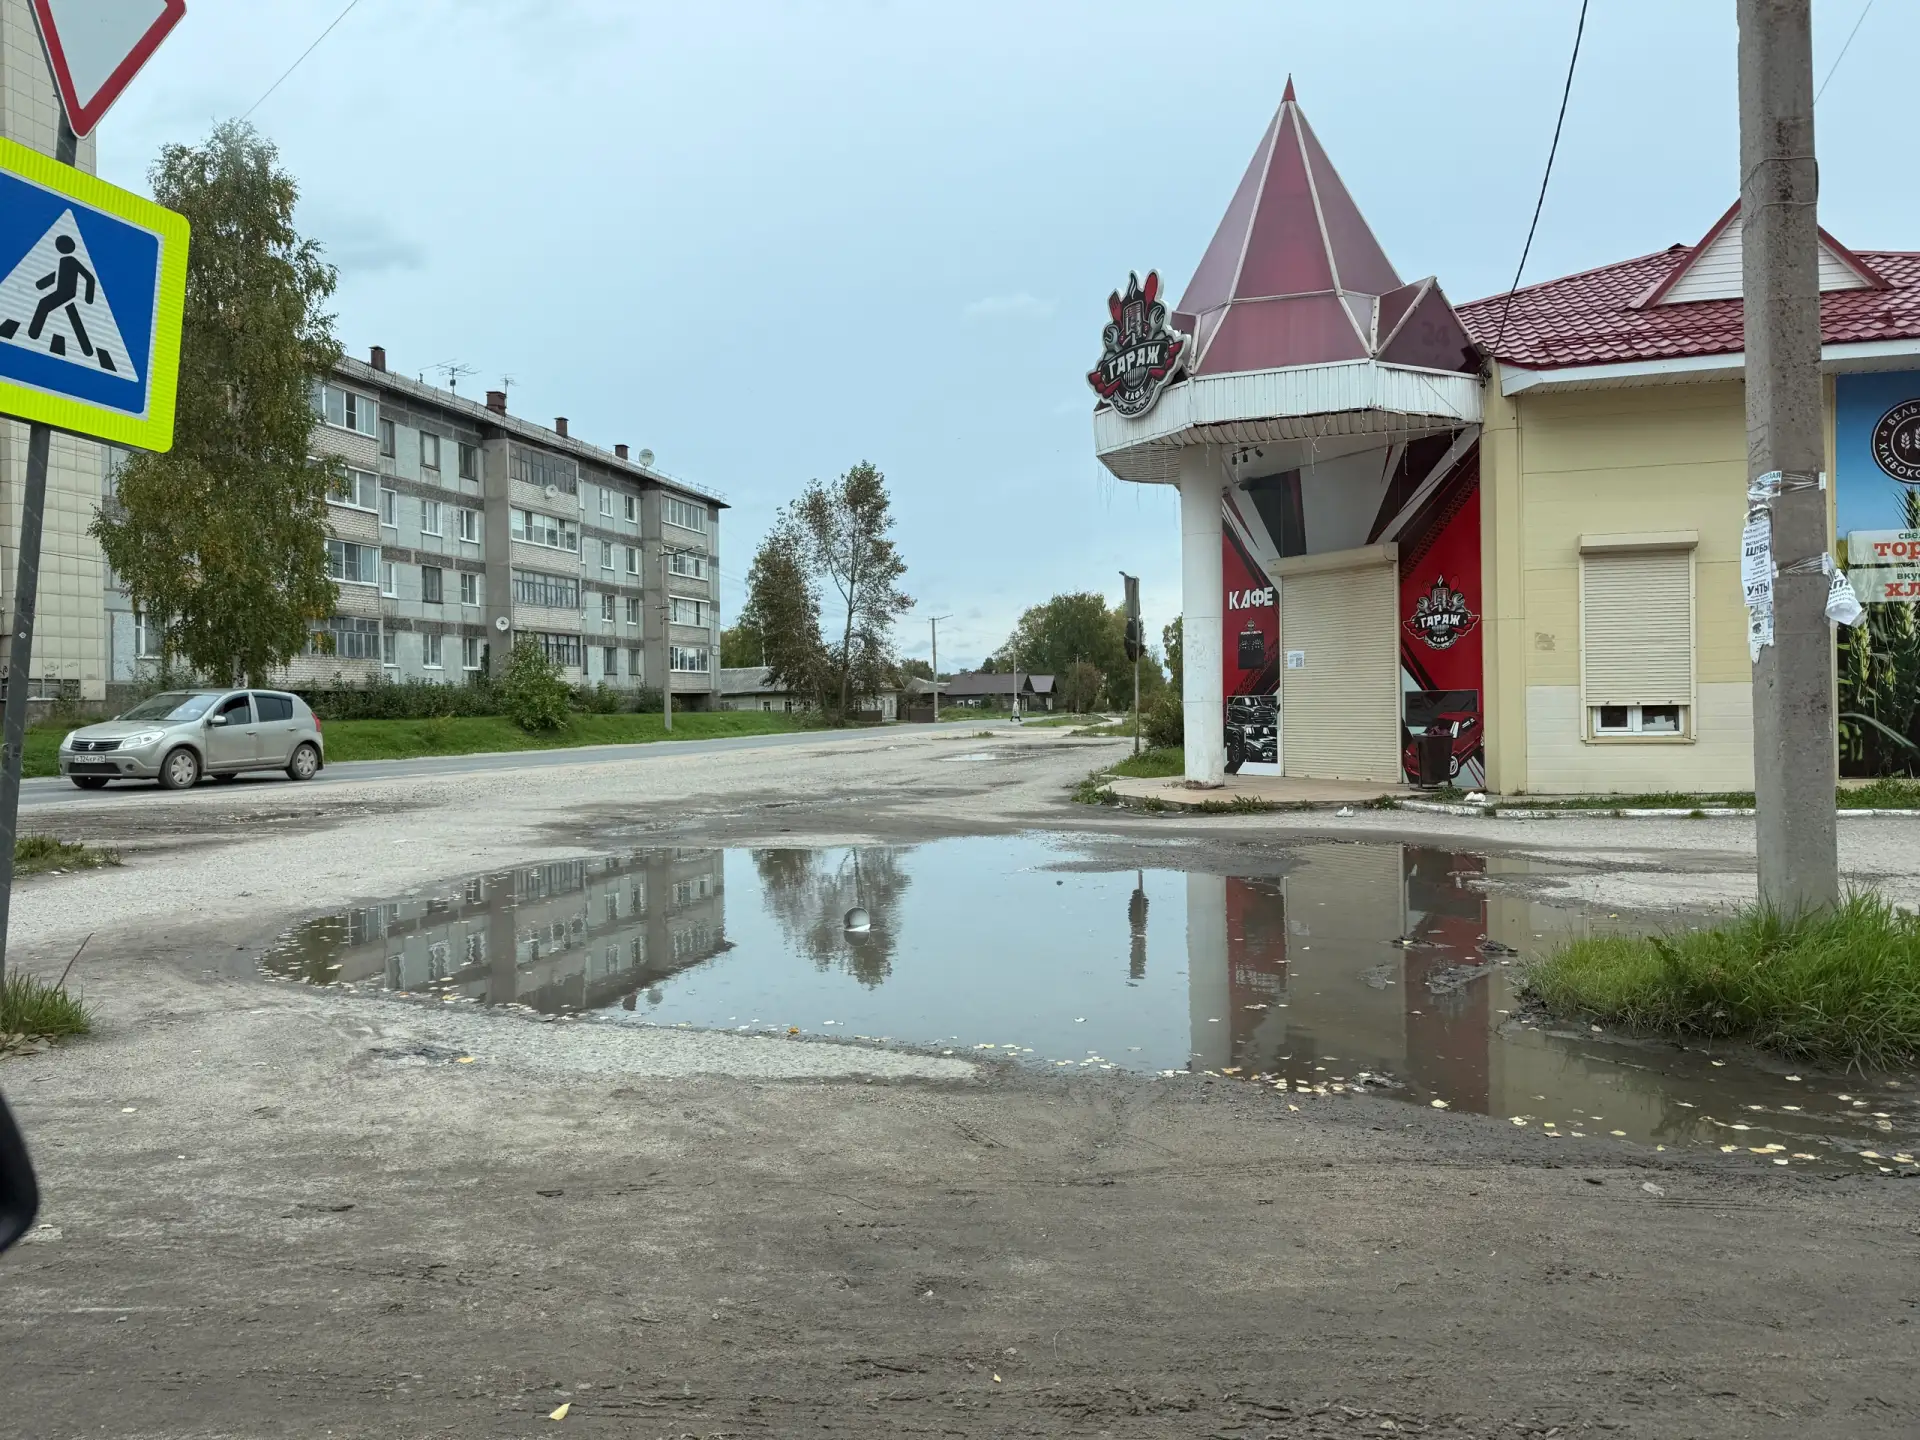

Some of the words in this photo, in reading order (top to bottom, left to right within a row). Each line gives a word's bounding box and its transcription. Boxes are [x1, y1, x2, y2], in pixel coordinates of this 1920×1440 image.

[1108, 344, 1160, 380] ГАРАЖ
[1125, 387, 1144, 400] КАФЕ
[1887, 406, 1920, 426] ВЕЛЬ
[1898, 532, 1920, 540] све
[1229, 586, 1274, 610] КАФЕ
[1420, 614, 1461, 628] ГАРАЖ
[1432, 635, 1449, 643] КАФЕ
